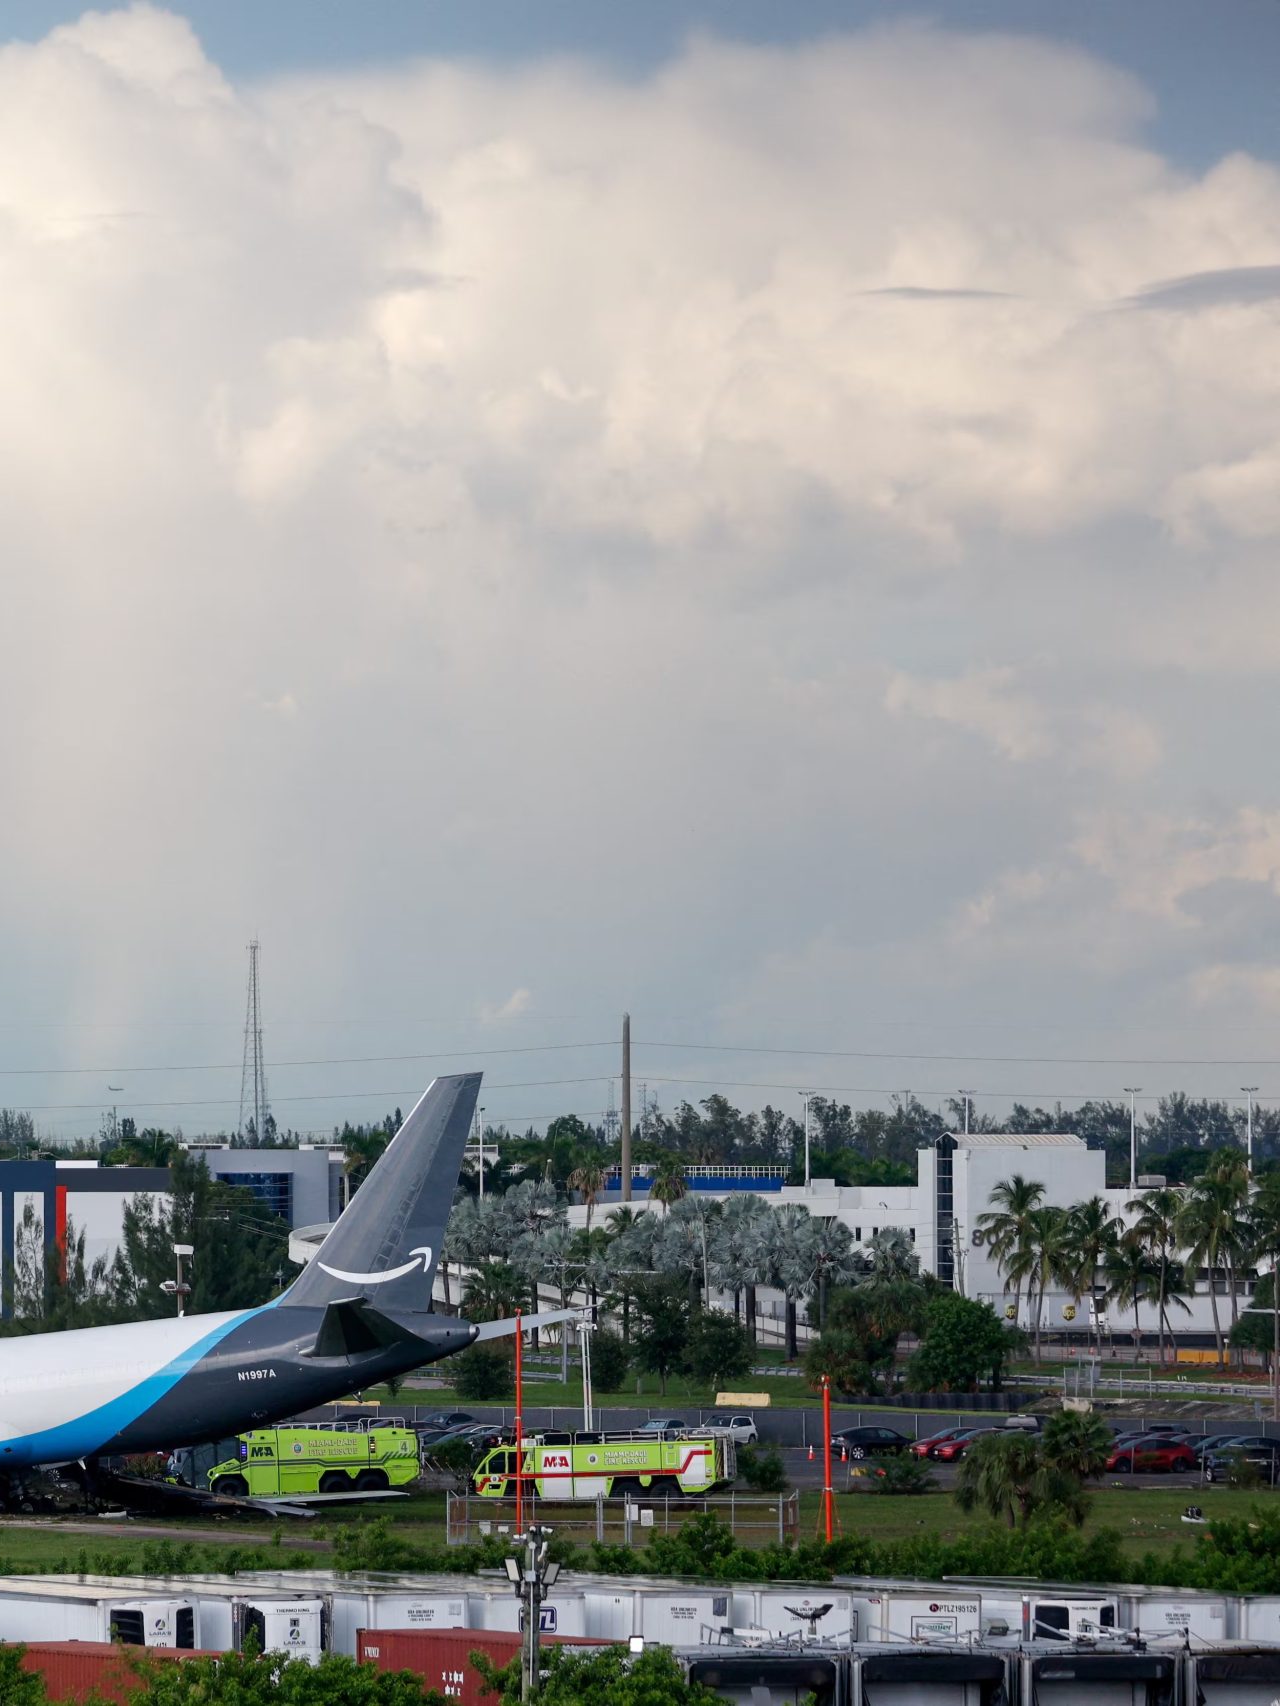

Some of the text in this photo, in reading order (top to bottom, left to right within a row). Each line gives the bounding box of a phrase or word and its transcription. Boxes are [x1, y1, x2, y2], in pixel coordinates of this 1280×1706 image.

[237, 1368, 277, 1381] N1997A
[308, 1438, 357, 1447] MIAMI-DADE
[400, 1441, 408, 1452] 4
[328, 1448, 358, 1456] RESCUE
[604, 1450, 647, 1459] MIAMI-DADE
[622, 1457, 648, 1466] RESCUE
